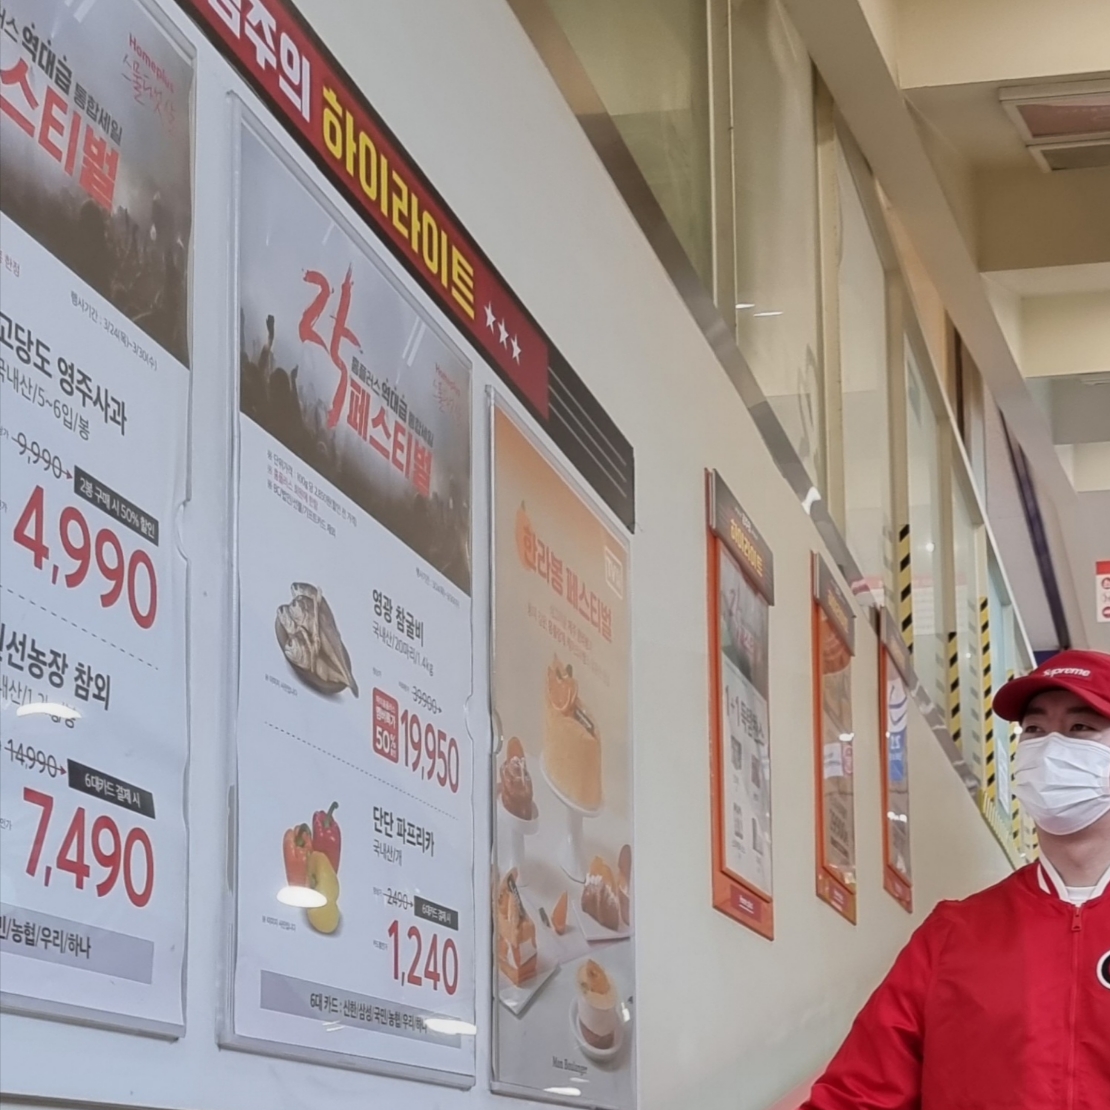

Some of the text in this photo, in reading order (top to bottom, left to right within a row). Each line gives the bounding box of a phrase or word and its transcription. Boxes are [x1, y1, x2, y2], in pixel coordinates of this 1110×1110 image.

[22, 22, 73, 96] 역대급
[73, 82, 123, 146] 통합세일
[129, 32, 174, 93] Homeplus
[323, 85, 475, 321] 하이라이트
[0, 311, 128, 436] 고당도 영주사과
[351, 356, 380, 396] 홈플러스
[381, 378, 407, 422] 역대급
[17, 432, 62, 479] 9,990
[347, 378, 432, 497] 페스티벌
[94, 487, 111, 510] 구매
[112, 501, 120, 516] 시
[120, 506, 140, 528] 50%
[140, 516, 156, 539] 할인
[13, 485, 157, 629] 4,990
[523, 525, 564, 597] 한라봉
[565, 566, 612, 644] 페스티벌
[373, 589, 424, 648] 영광 참굴비
[74, 661, 111, 711] 참외
[7, 738, 58, 778] 14,990
[401, 709, 459, 793] 19,950
[132, 792, 141, 808] 시
[373, 806, 435, 857] 단단 파프리카
[23, 787, 154, 907] 7,490
[388, 919, 459, 995] 1,240
